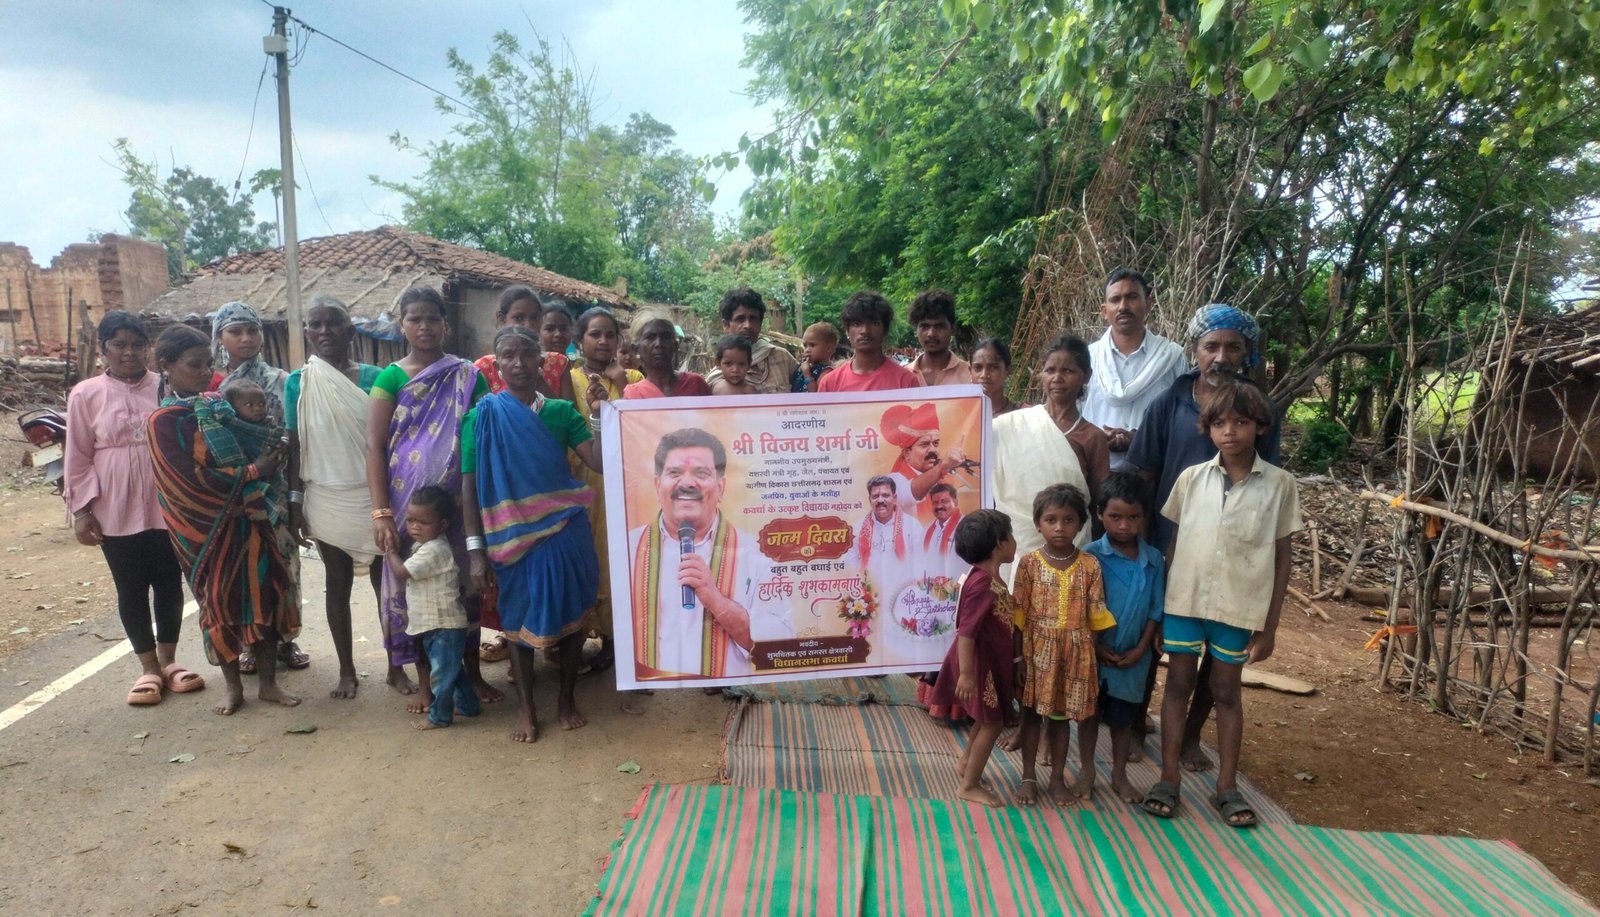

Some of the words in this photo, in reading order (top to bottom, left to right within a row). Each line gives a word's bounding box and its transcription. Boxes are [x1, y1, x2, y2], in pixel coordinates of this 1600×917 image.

[781, 416, 826, 430] आदरणीय
[733, 432, 754, 455] श्री
[760, 431, 809, 454] विजय
[816, 429, 851, 451] शर्मा
[856, 427, 879, 450] जी
[817, 467, 839, 475] पंचायत
[768, 480, 789, 489] विकास
[823, 477, 842, 487] शासन
[811, 488, 819, 498] के
[820, 488, 841, 498] मसीहा
[743, 503, 766, 514] कवर्धा
[767, 503, 776, 514] के
[801, 500, 830, 514] विधायक
[831, 501, 852, 512] महोदय
[853, 502, 863, 510] को
[767, 532, 802, 546] जन्म
[806, 523, 849, 545] दिवस
[770, 565, 788, 577] बहुत
[790, 563, 808, 576] बहुत
[810, 561, 832, 572] बधाई
[834, 561, 845, 571] एवं
[758, 576, 795, 601] हार्दिक
[799, 575, 864, 600] शुभकामनाएं
[799, 640, 819, 648] भवदीय
[808, 648, 828, 656] समस्त
[773, 656, 820, 668] विधानसभा
[822, 653, 849, 664] कवर्धा
